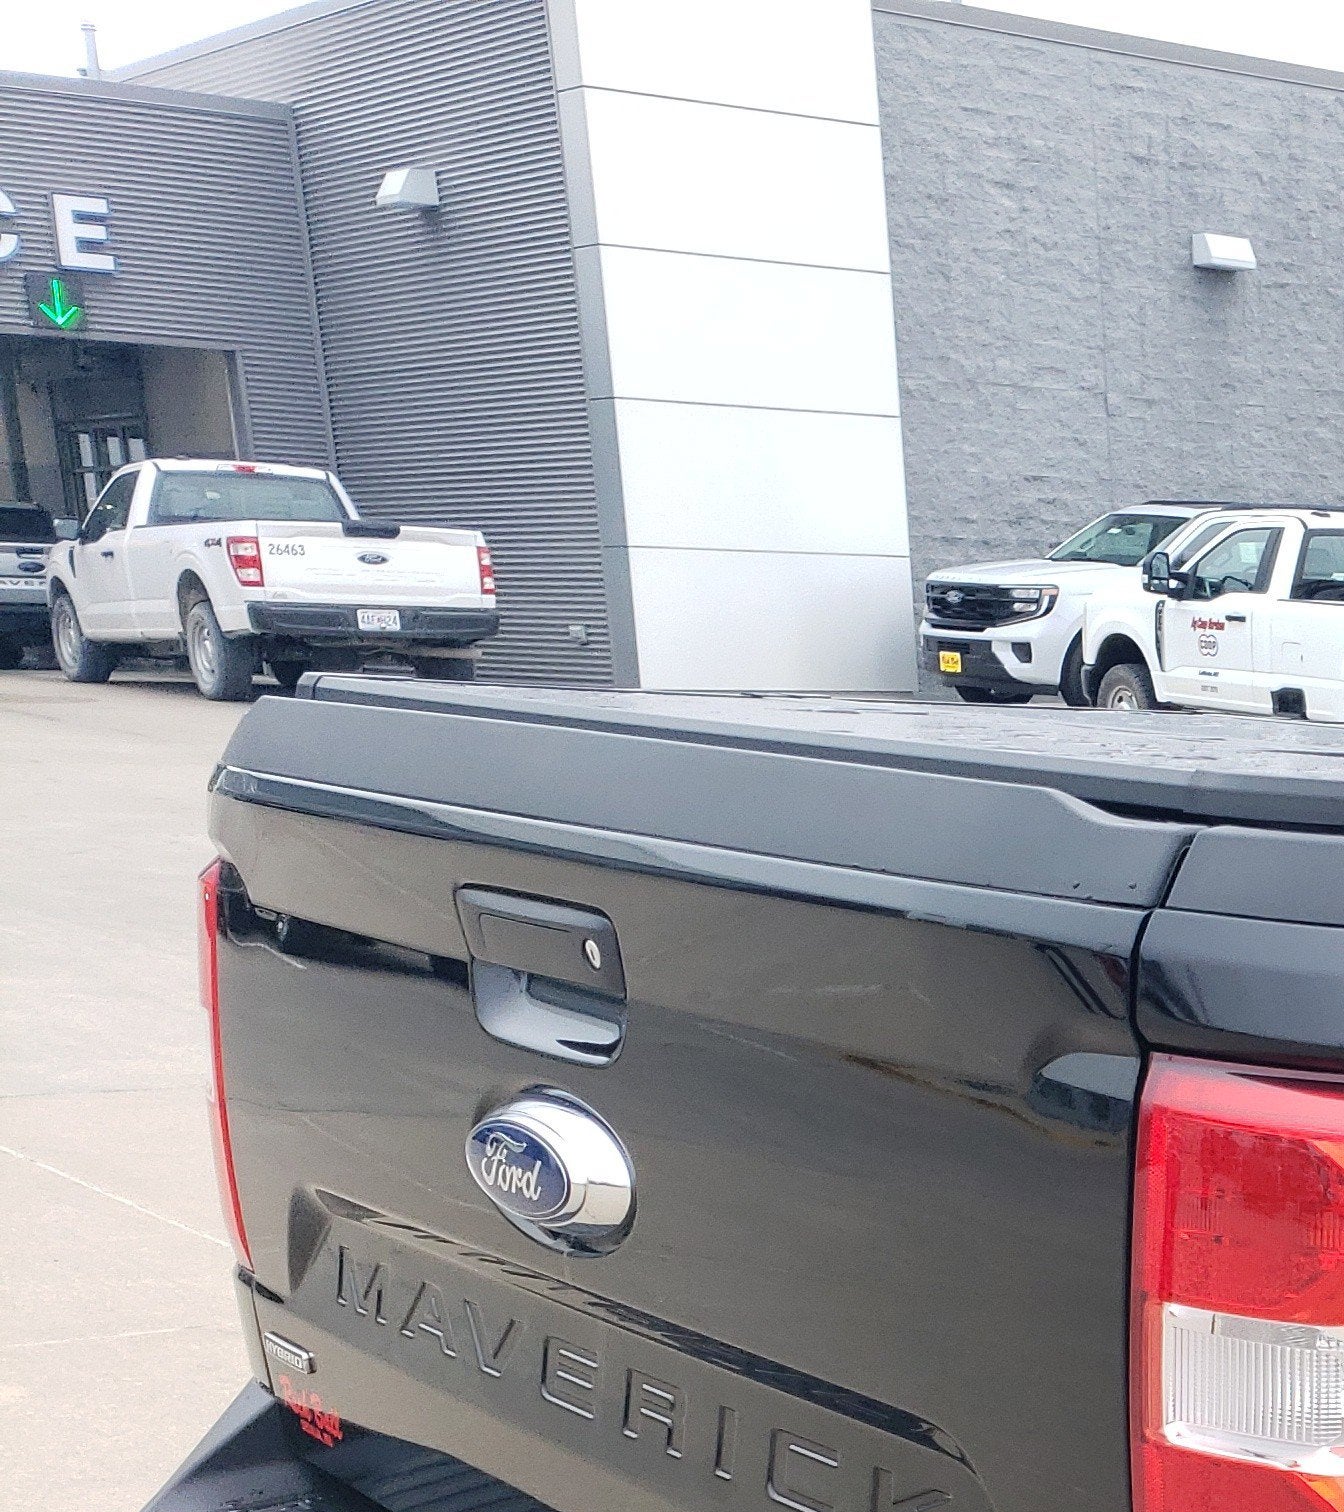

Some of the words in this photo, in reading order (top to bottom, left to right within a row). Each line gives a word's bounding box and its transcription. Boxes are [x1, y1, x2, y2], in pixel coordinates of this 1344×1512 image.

[268, 543, 306, 556] 26463
[480, 1131, 542, 1201] Ford
[264, 1338, 305, 1371] HYBRID
